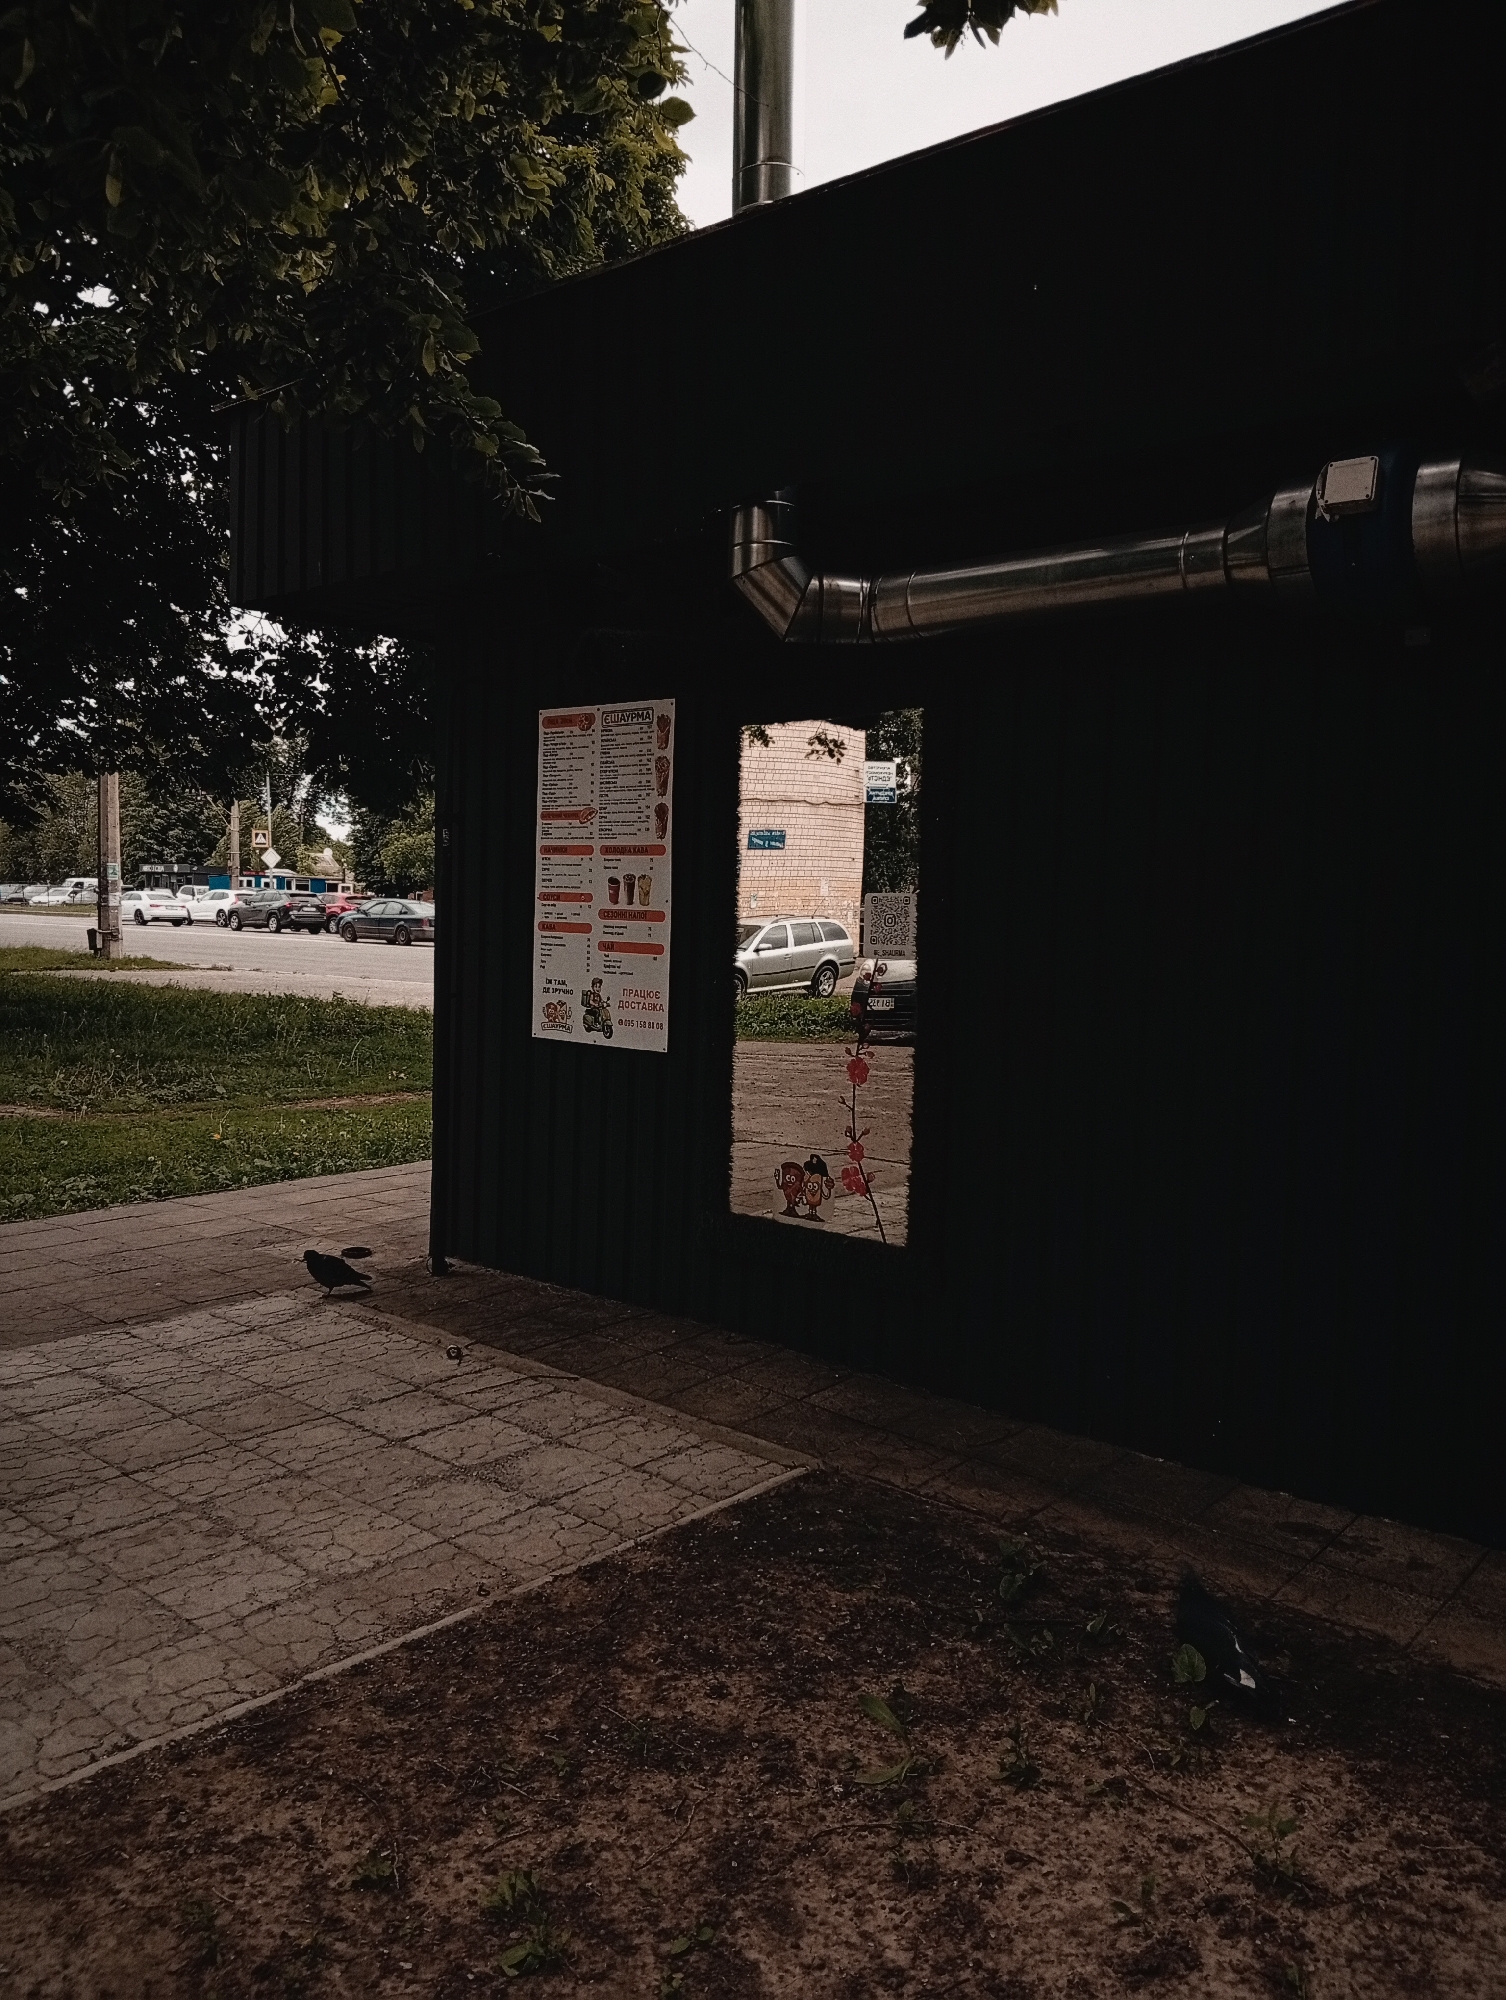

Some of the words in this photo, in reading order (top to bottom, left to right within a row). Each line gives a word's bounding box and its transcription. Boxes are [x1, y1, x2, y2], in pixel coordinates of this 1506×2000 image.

[604, 711, 651, 724] ЄШАУРМА
[633, 846, 649, 854] КАВА
[603, 910, 627, 919] СЕЗОННІ
[602, 942, 615, 951] ЧАЙ
[552, 987, 574, 996] ЗРУЧНО
[622, 988, 661, 1000] ПРАЦЮЄ
[617, 1000, 665, 1013] ДОСТАВКА
[655, 1022, 664, 1031] 08
